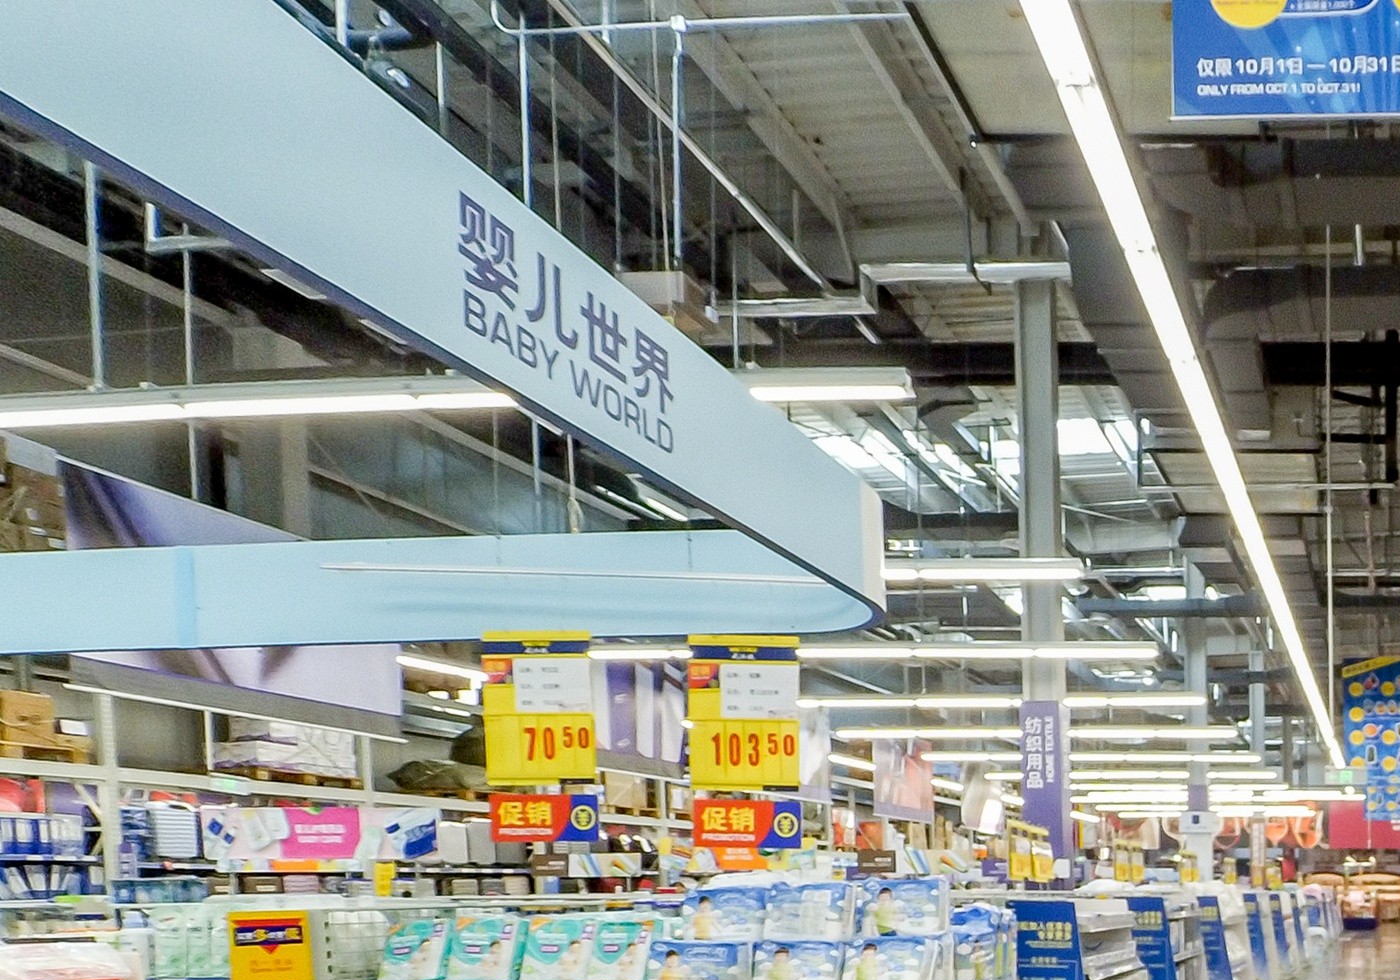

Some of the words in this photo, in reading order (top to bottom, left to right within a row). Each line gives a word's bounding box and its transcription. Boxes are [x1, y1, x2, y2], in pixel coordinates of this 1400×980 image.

[1197, 84, 1228, 96] ONLY
[1230, 83, 1264, 95] FROM
[1301, 82, 1315, 94] TO
[459, 190, 674, 414] 婴儿世界
[463, 288, 559, 380] BABY
[569, 359, 674, 453] WORLD
[497, 800, 553, 826] 促销
[701, 806, 755, 832] 促销
